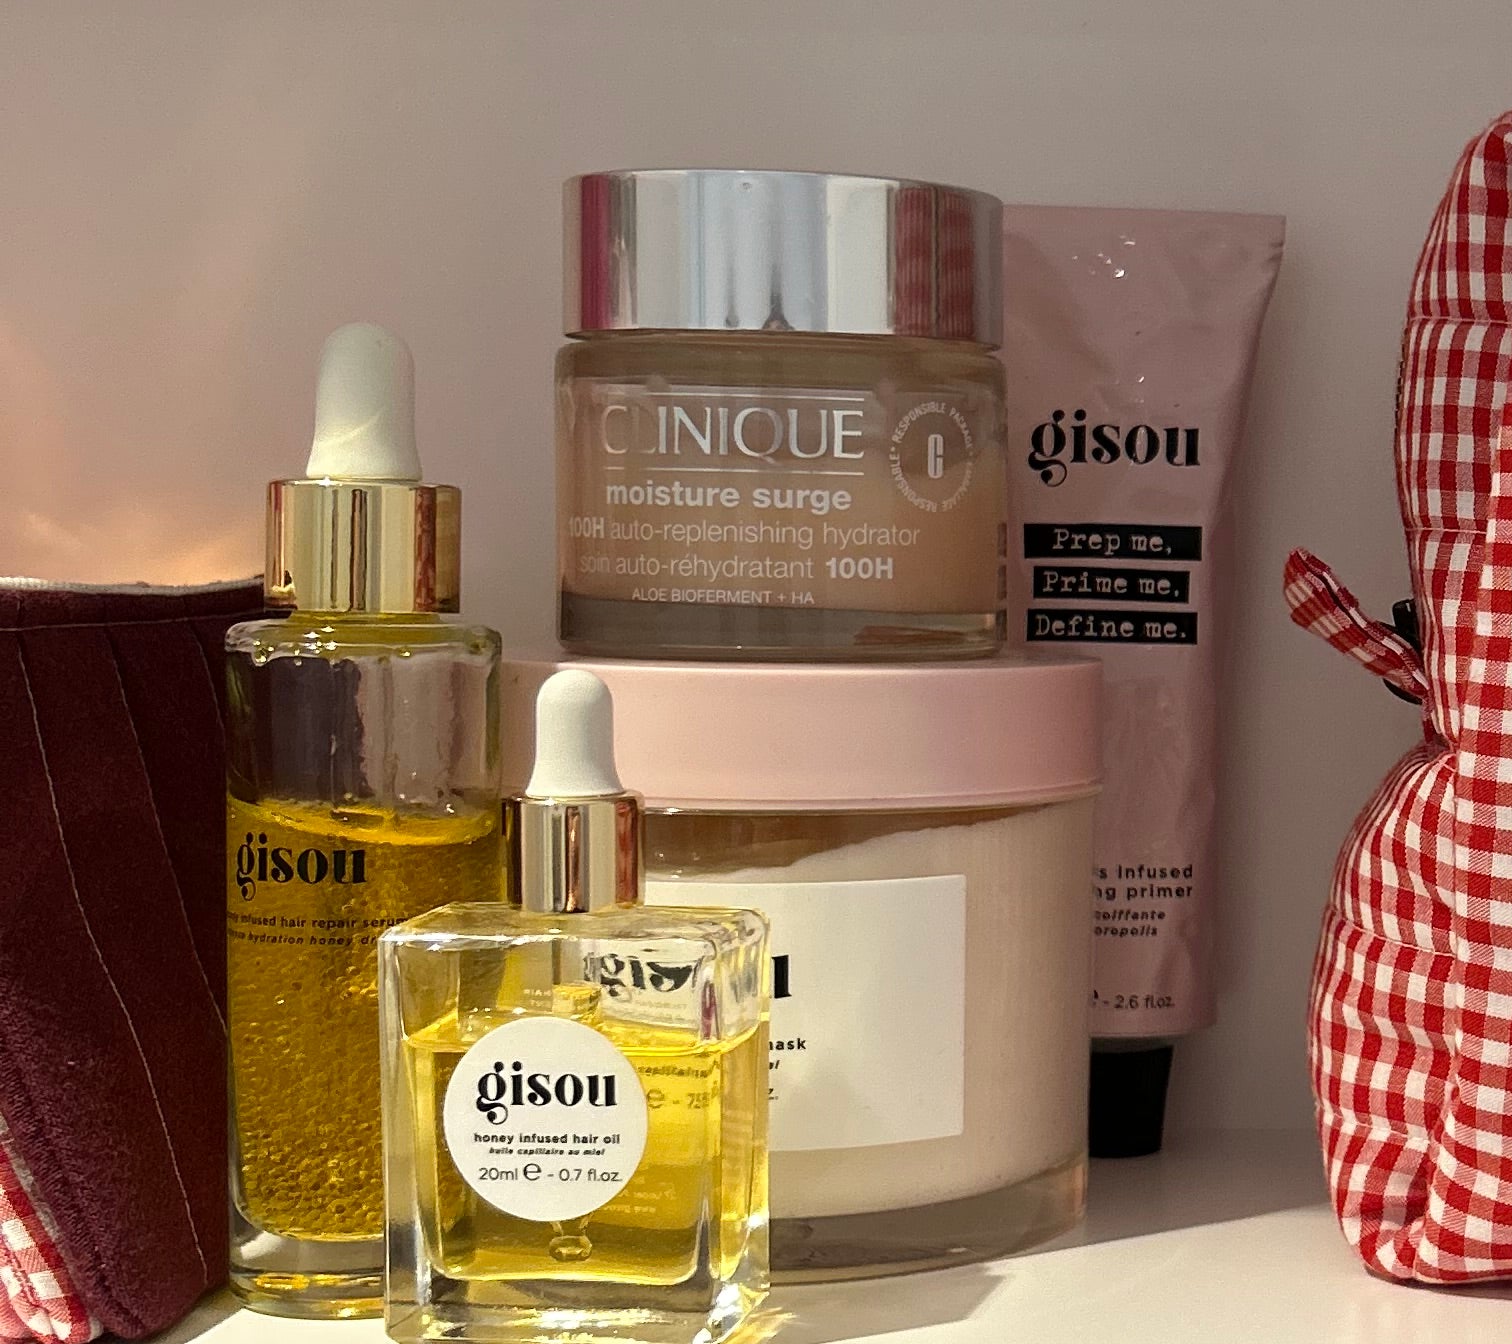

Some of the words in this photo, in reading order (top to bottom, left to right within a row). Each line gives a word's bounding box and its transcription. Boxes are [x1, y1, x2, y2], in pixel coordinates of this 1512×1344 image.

[603, 404, 865, 464] CLINIQUE
[1027, 409, 1201, 487] gisou
[605, 481, 740, 507] moisture
[752, 486, 852, 515] surge
[568, 517, 605, 539] 100H
[610, 520, 814, 549] auto-replenishing
[823, 522, 920, 547] hydrator
[1052, 528, 1121, 555] Prep
[1131, 534, 1172, 554] me,
[580, 556, 610, 575] soin
[615, 553, 815, 582] auto-réhydratant
[826, 556, 894, 580] 100H
[631, 588, 669, 603] ALOE
[671, 588, 772, 605] BIOFERMENT
[791, 589, 815, 605] HA
[1042, 570, 1128, 594] Prime
[1139, 576, 1180, 597] me,
[1035, 613, 1135, 637] Define
[1145, 621, 1187, 638] me.
[236, 832, 367, 901] gisou
[1117, 864, 1194, 880] infused
[1126, 884, 1193, 901] primer
[280, 915, 306, 928] hair
[312, 918, 357, 931] repair
[248, 931, 304, 946] hydration
[309, 935, 353, 947] honey
[475, 1061, 618, 1125] gisou
[474, 1133, 514, 1145] honey
[519, 1133, 568, 1144] infused
[573, 1133, 598, 1144] hair
[603, 1133, 621, 1144] oil
[489, 1147, 514, 1155] huile
[517, 1147, 565, 1156] capillaire
[583, 1148, 606, 1156] miel
[478, 1167, 519, 1182] 20ml
[558, 1167, 583, 1182] 0.7
